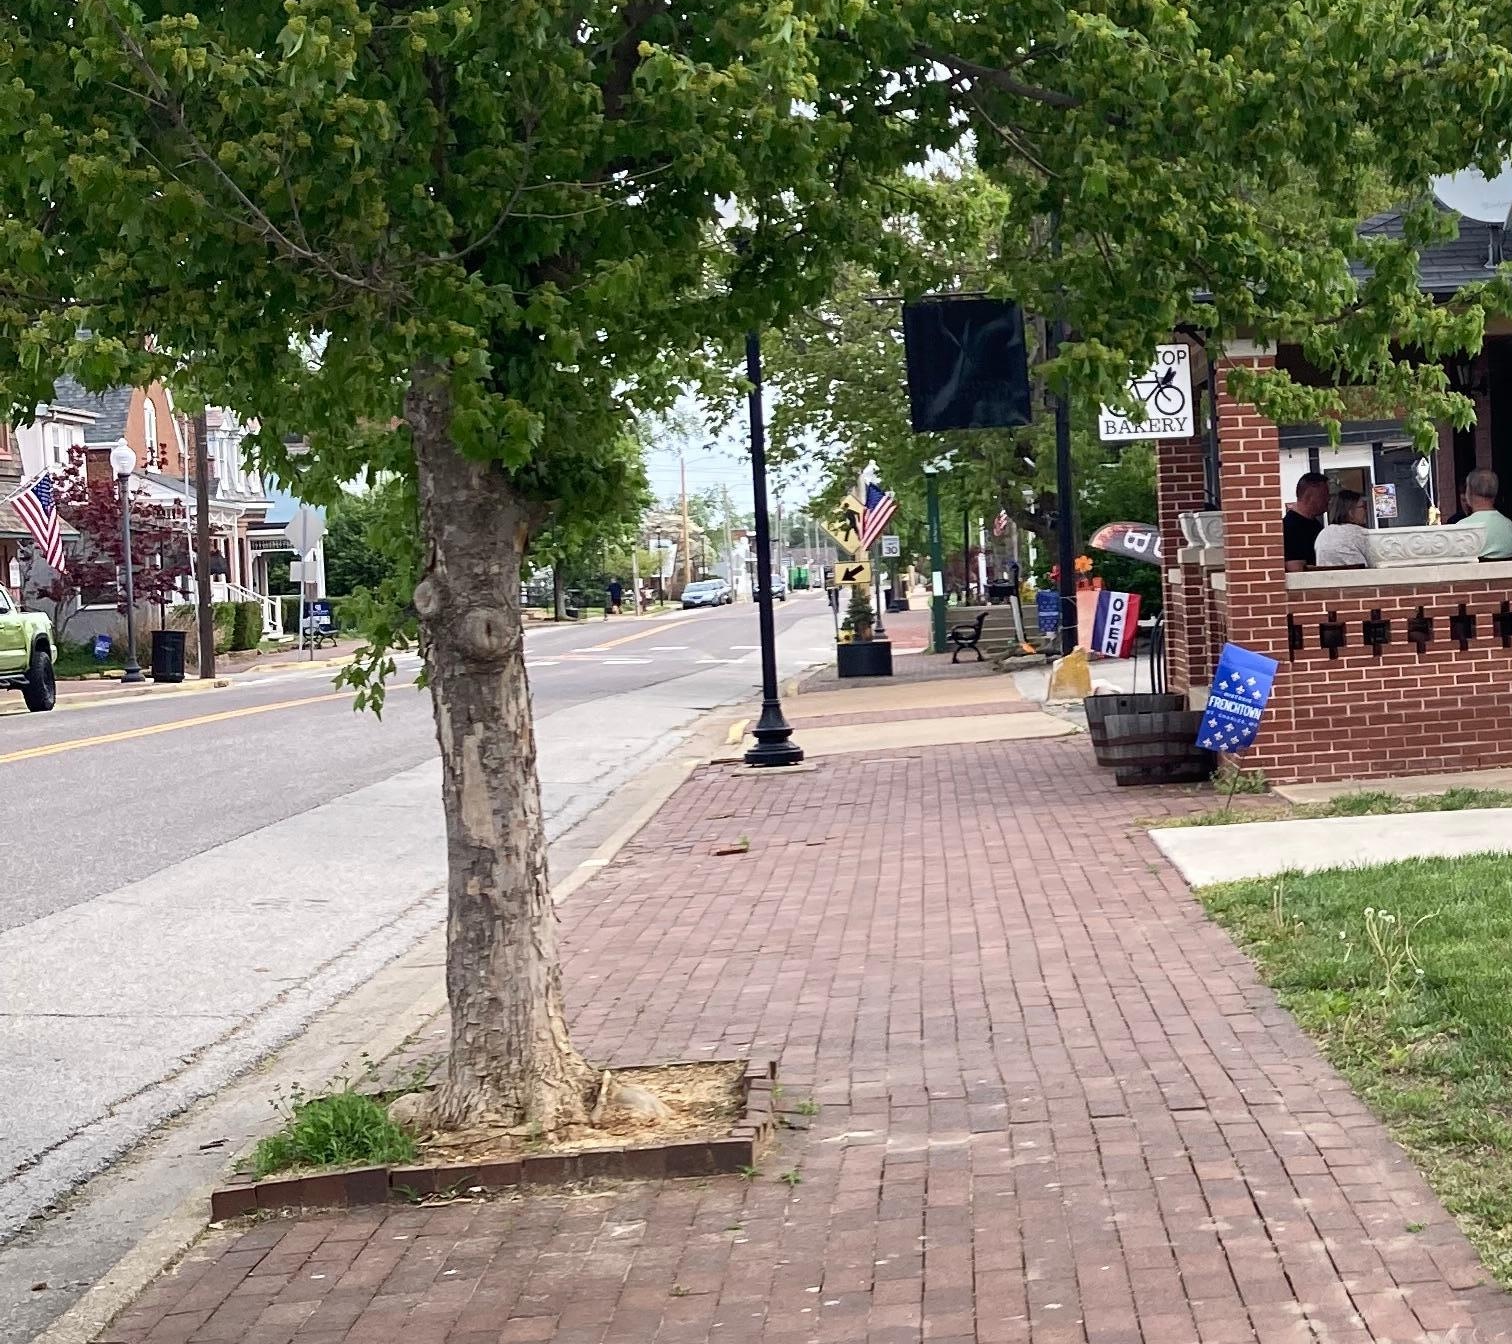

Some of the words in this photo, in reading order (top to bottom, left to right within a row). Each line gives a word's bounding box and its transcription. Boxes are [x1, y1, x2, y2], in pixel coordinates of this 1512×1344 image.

[1155, 349, 1187, 366] TOP
[884, 546, 898, 554] 30
[1105, 597, 1125, 655] OPEN
